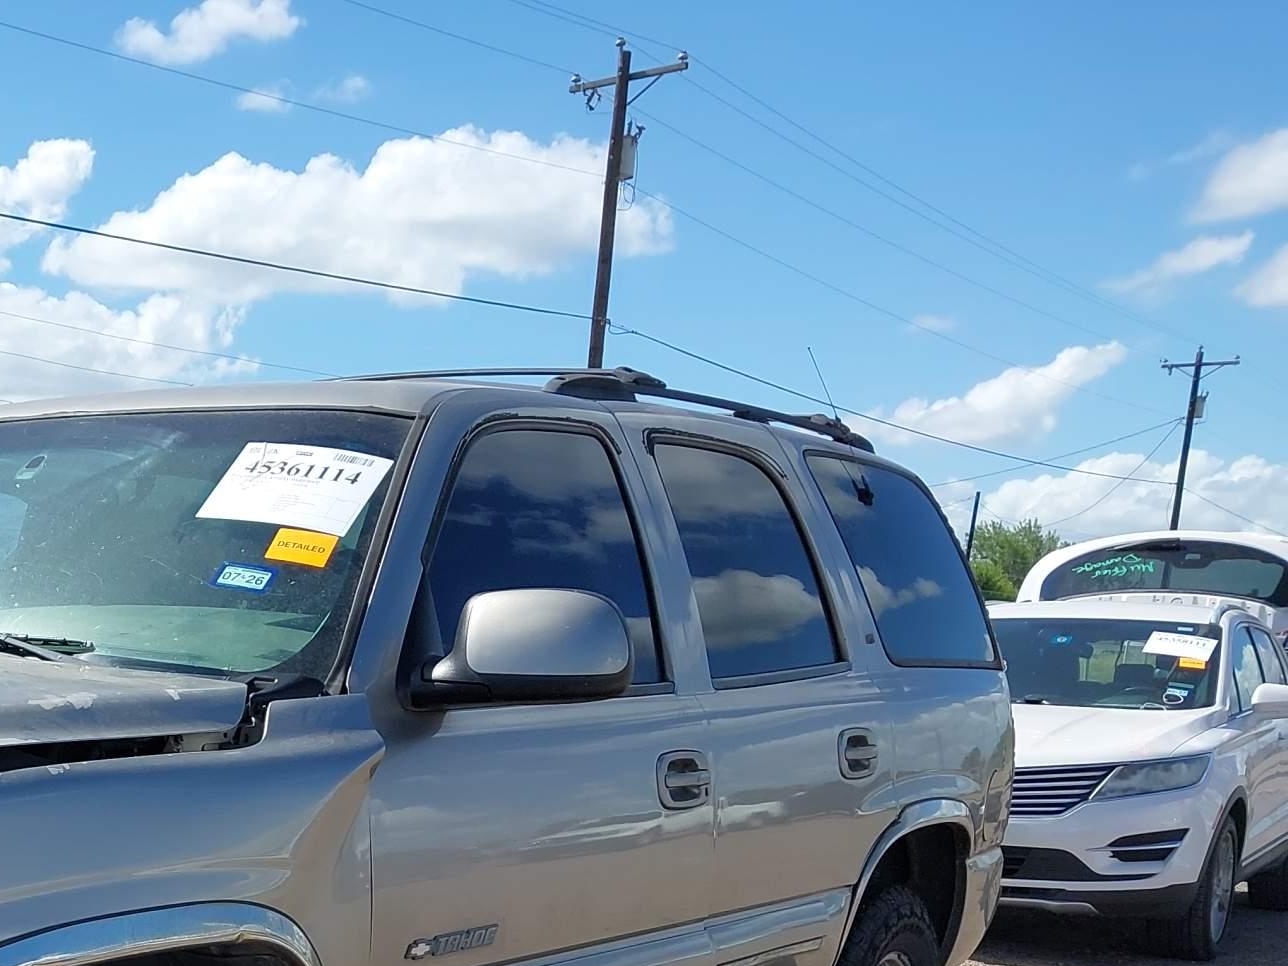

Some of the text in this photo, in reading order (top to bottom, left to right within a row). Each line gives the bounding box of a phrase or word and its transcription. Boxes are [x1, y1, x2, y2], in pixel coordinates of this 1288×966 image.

[245, 460, 362, 485] 45361114
[277, 540, 326, 554] DETAILED
[435, 926, 498, 955] TAHOE
